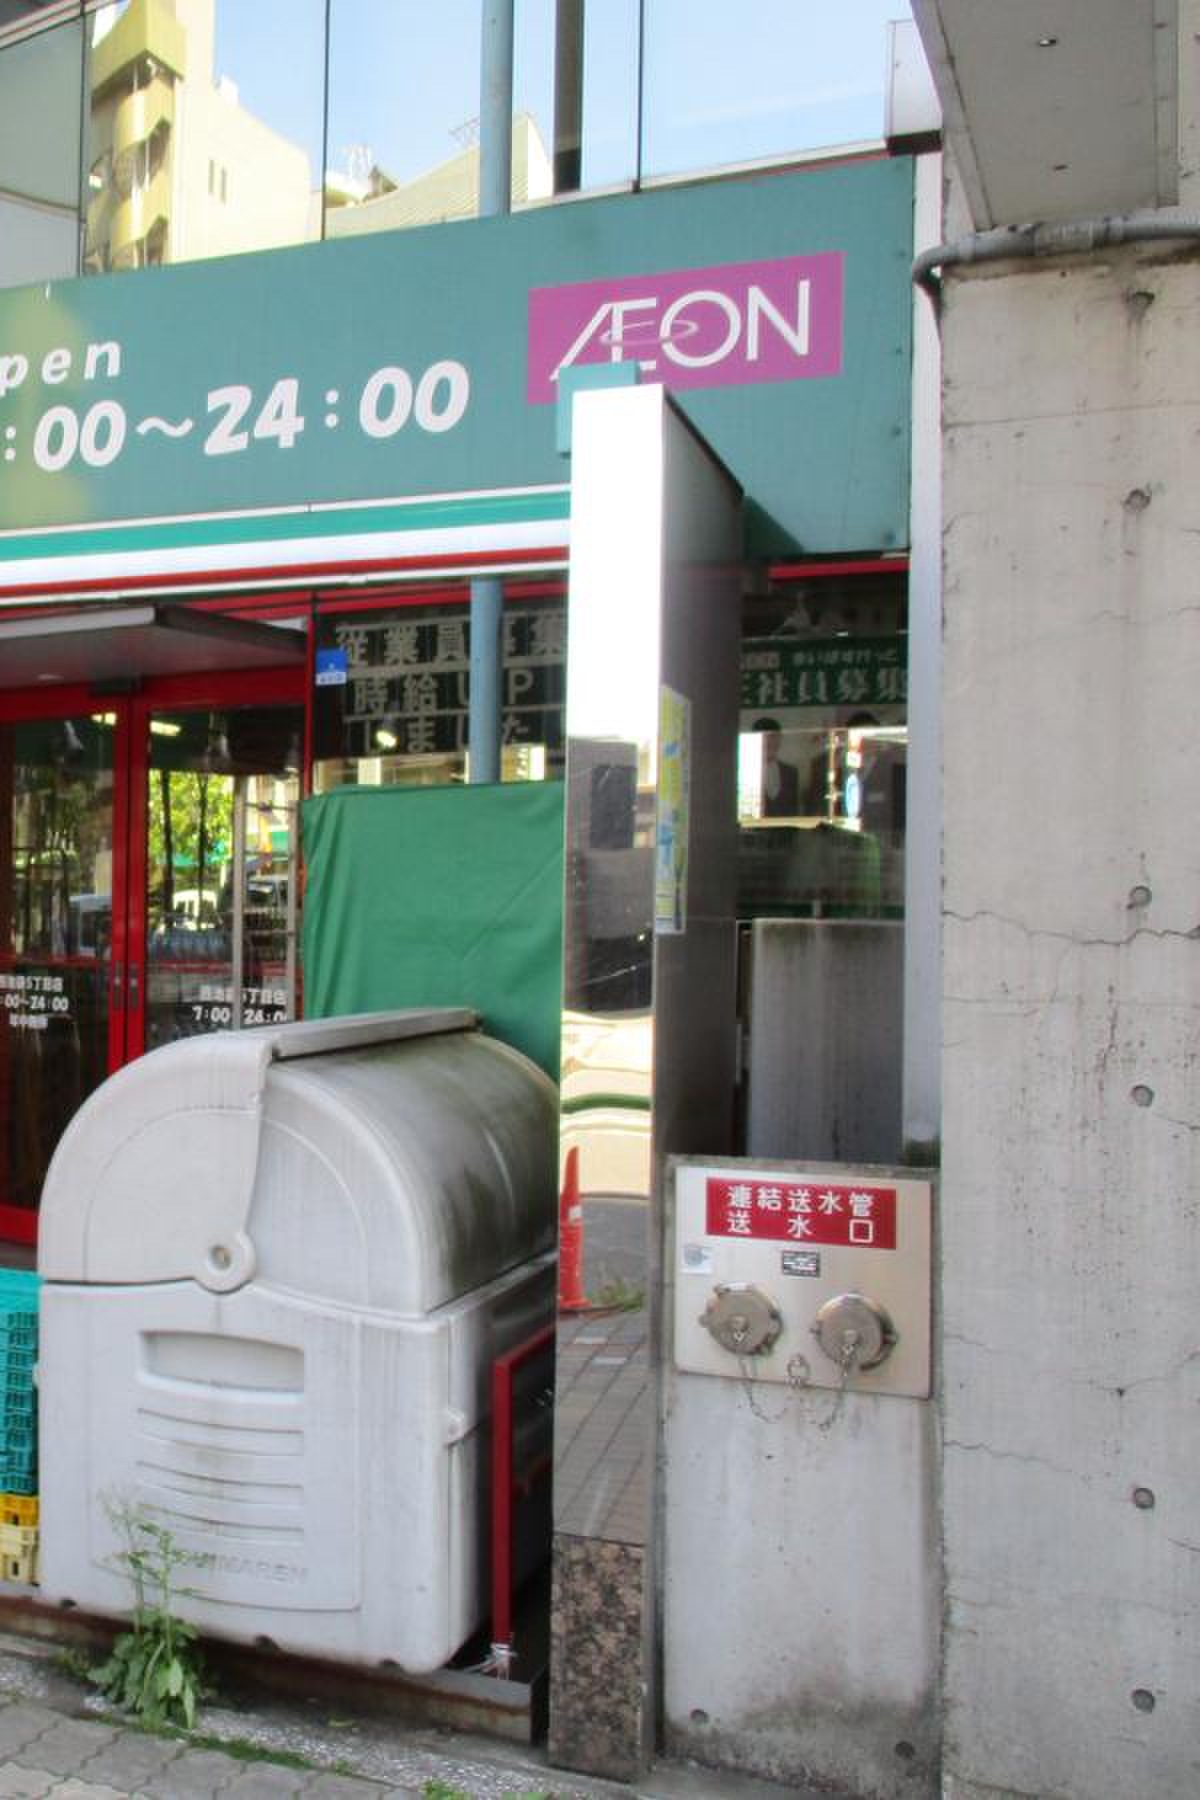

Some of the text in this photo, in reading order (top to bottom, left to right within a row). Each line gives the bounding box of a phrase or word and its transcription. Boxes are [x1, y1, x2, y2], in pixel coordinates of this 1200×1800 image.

[726, 1184, 874, 1217] 連結送水管
